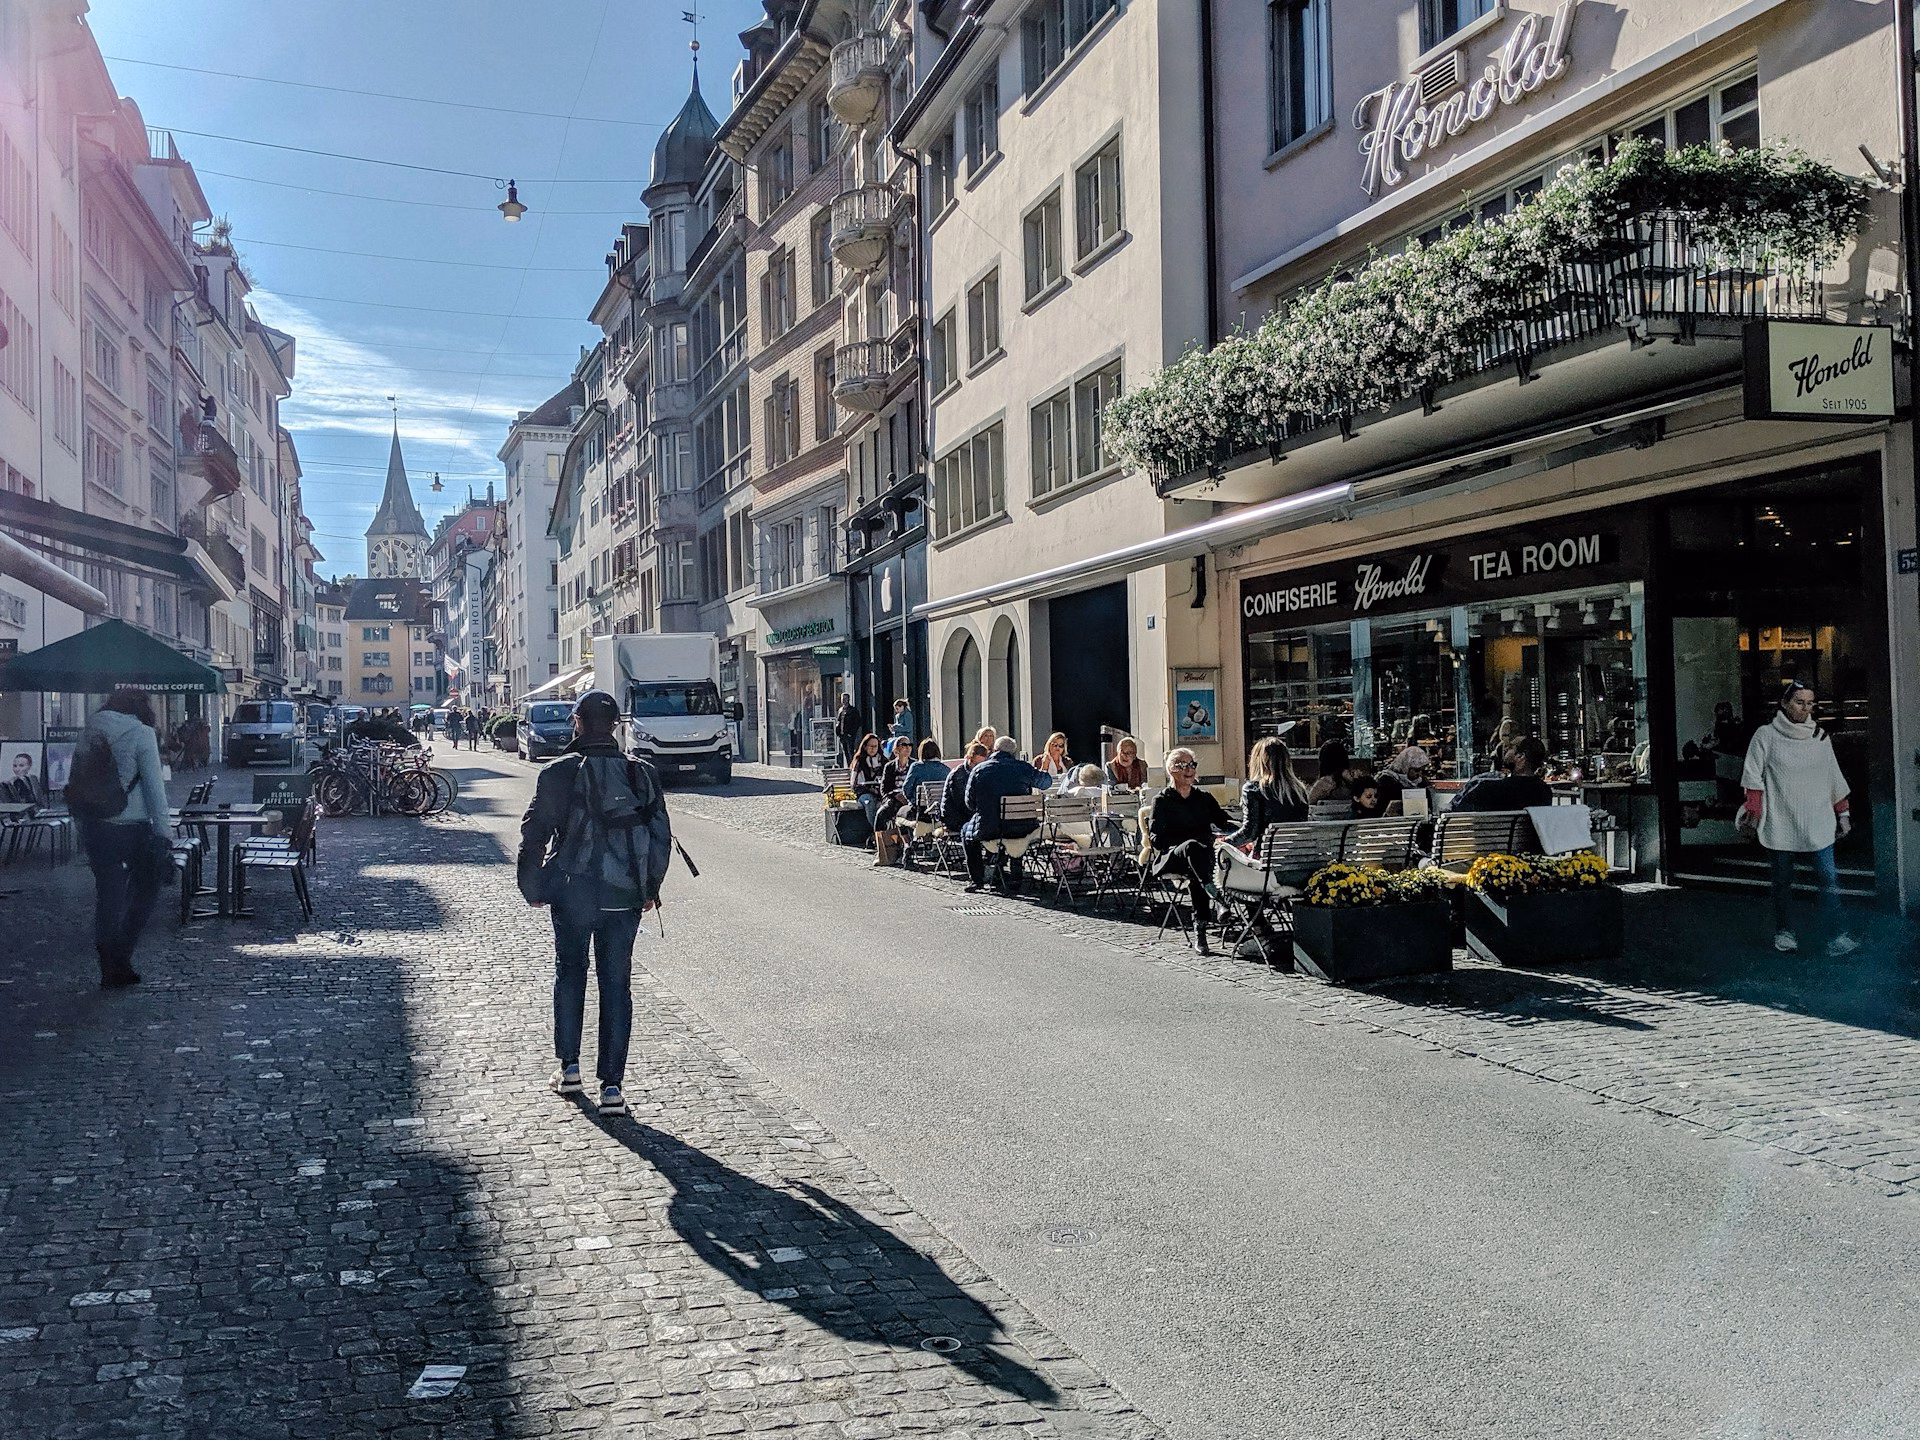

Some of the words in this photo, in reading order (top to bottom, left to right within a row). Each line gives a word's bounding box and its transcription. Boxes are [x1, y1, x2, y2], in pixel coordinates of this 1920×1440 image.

[1351, 0, 1577, 196] Honold
[1788, 332, 1874, 398] Honold
[1844, 399, 1867, 410] 1905
[1243, 580, 1338, 618] CONFISERIE
[1353, 554, 1433, 611] Honold
[1469, 550, 1512, 582] TEA
[1522, 534, 1601, 574] ROOM
[114, 683, 170, 691] STARBUCKS
